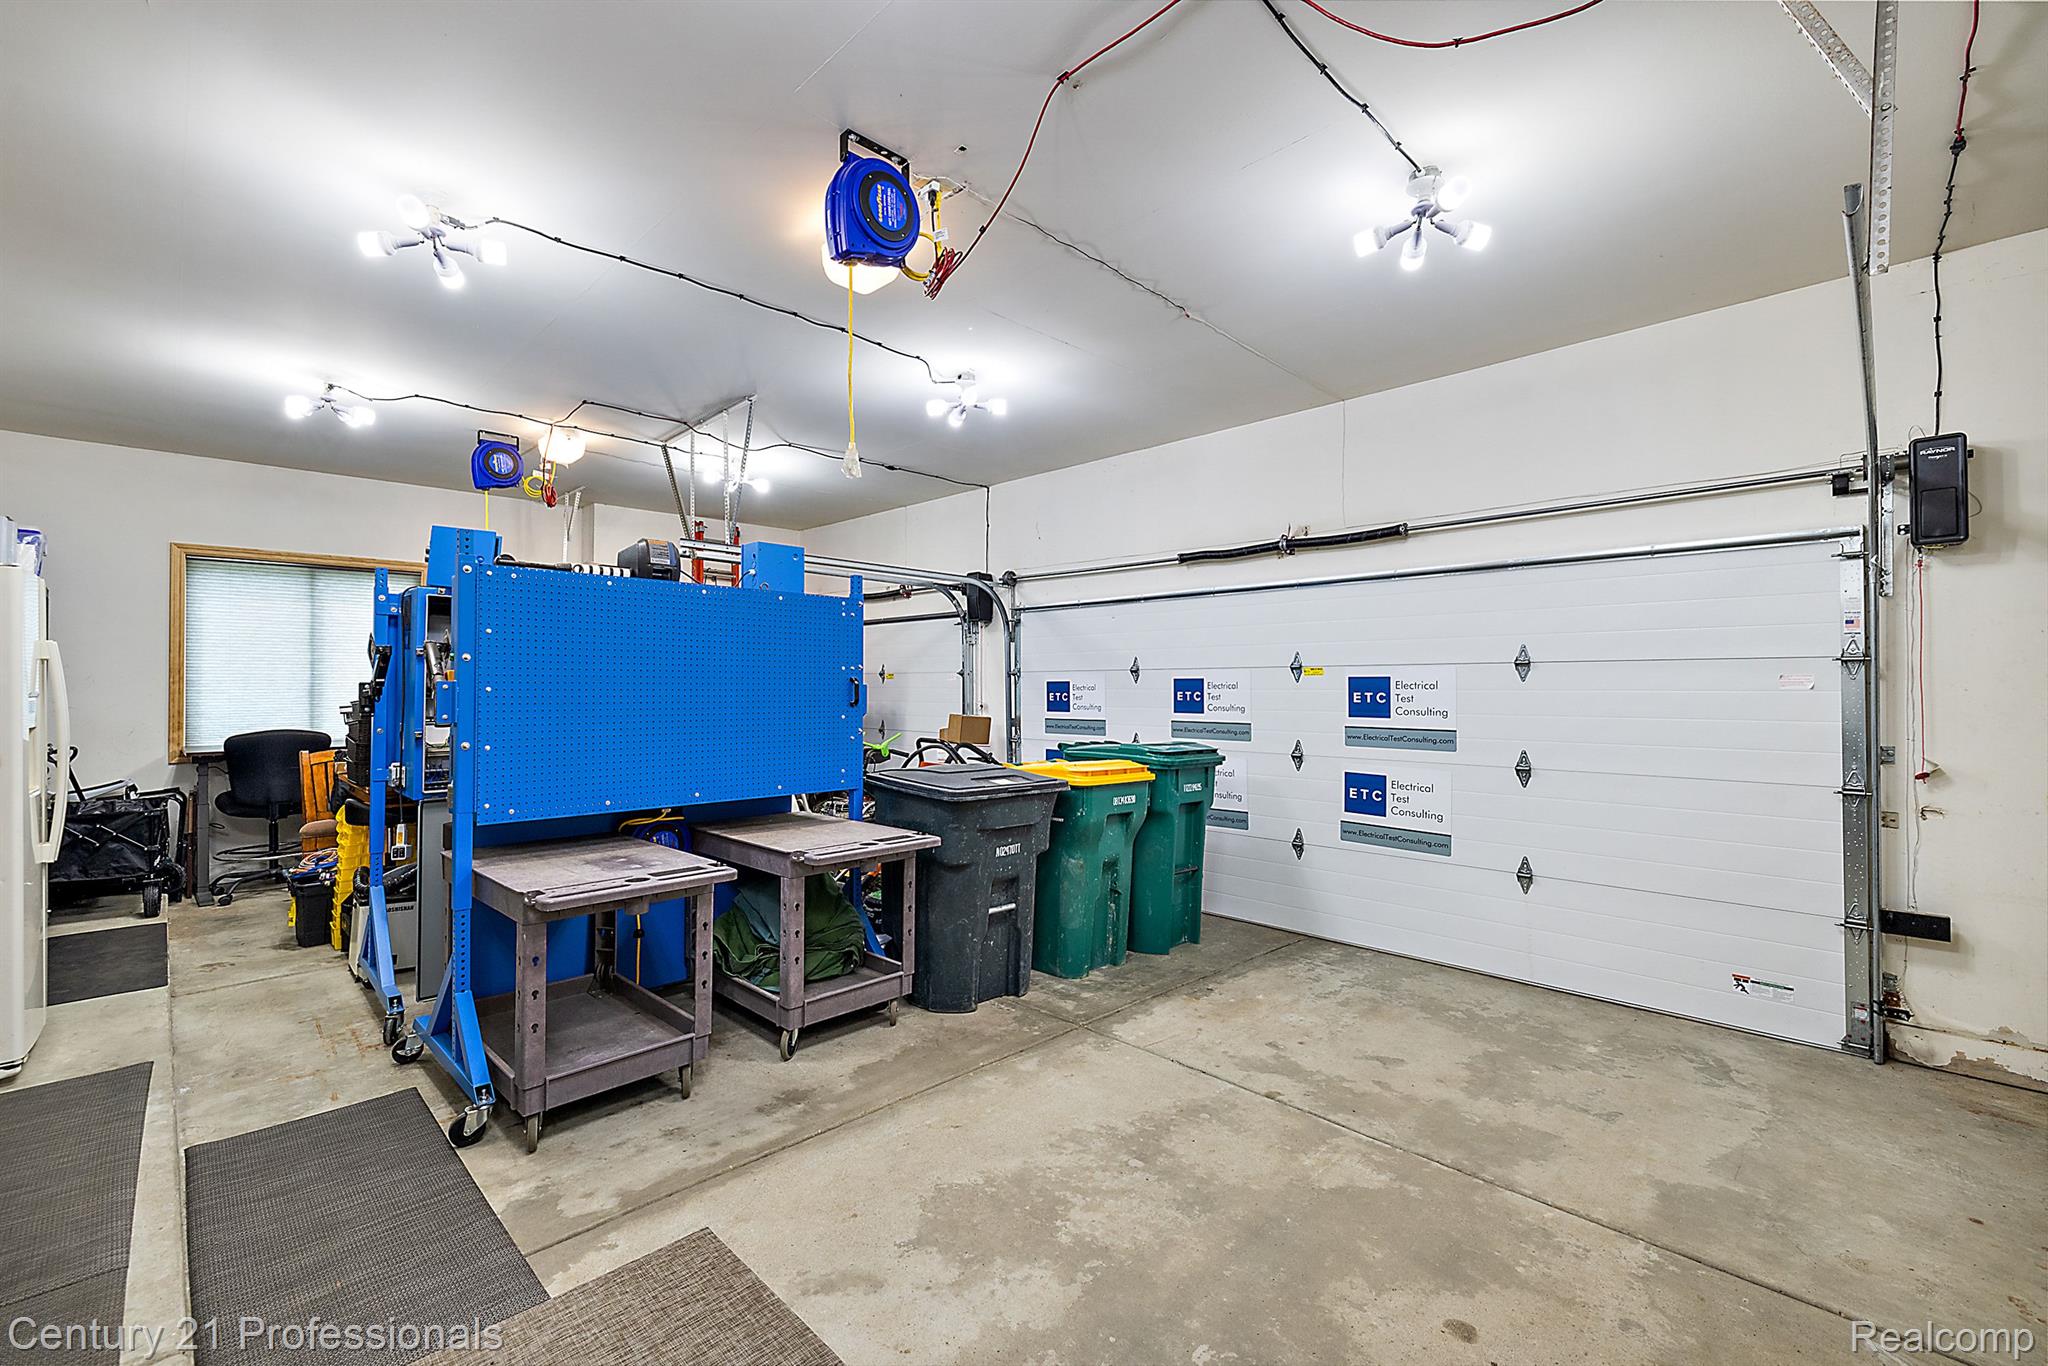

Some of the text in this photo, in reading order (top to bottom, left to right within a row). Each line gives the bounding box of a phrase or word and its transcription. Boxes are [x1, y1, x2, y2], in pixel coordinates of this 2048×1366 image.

[1919, 446, 1956, 455] RAYNOR
[1207, 682, 1238, 690] Electrical
[1395, 681, 1438, 690] Electrical
[1049, 693, 1068, 701] ETC
[1177, 692, 1201, 701] ETC
[1353, 692, 1386, 703] ETC
[1395, 694, 1414, 703] Test
[1072, 703, 1102, 712] Consulting
[1207, 704, 1245, 713] Consulting
[1395, 707, 1448, 719] Consulting
[1391, 780, 1434, 793] Electrical
[1215, 791, 1242, 802] nsulting
[1349, 788, 1382, 801] ETC
[1391, 793, 1409, 803] Test
[1391, 806, 1443, 822] Consulting
